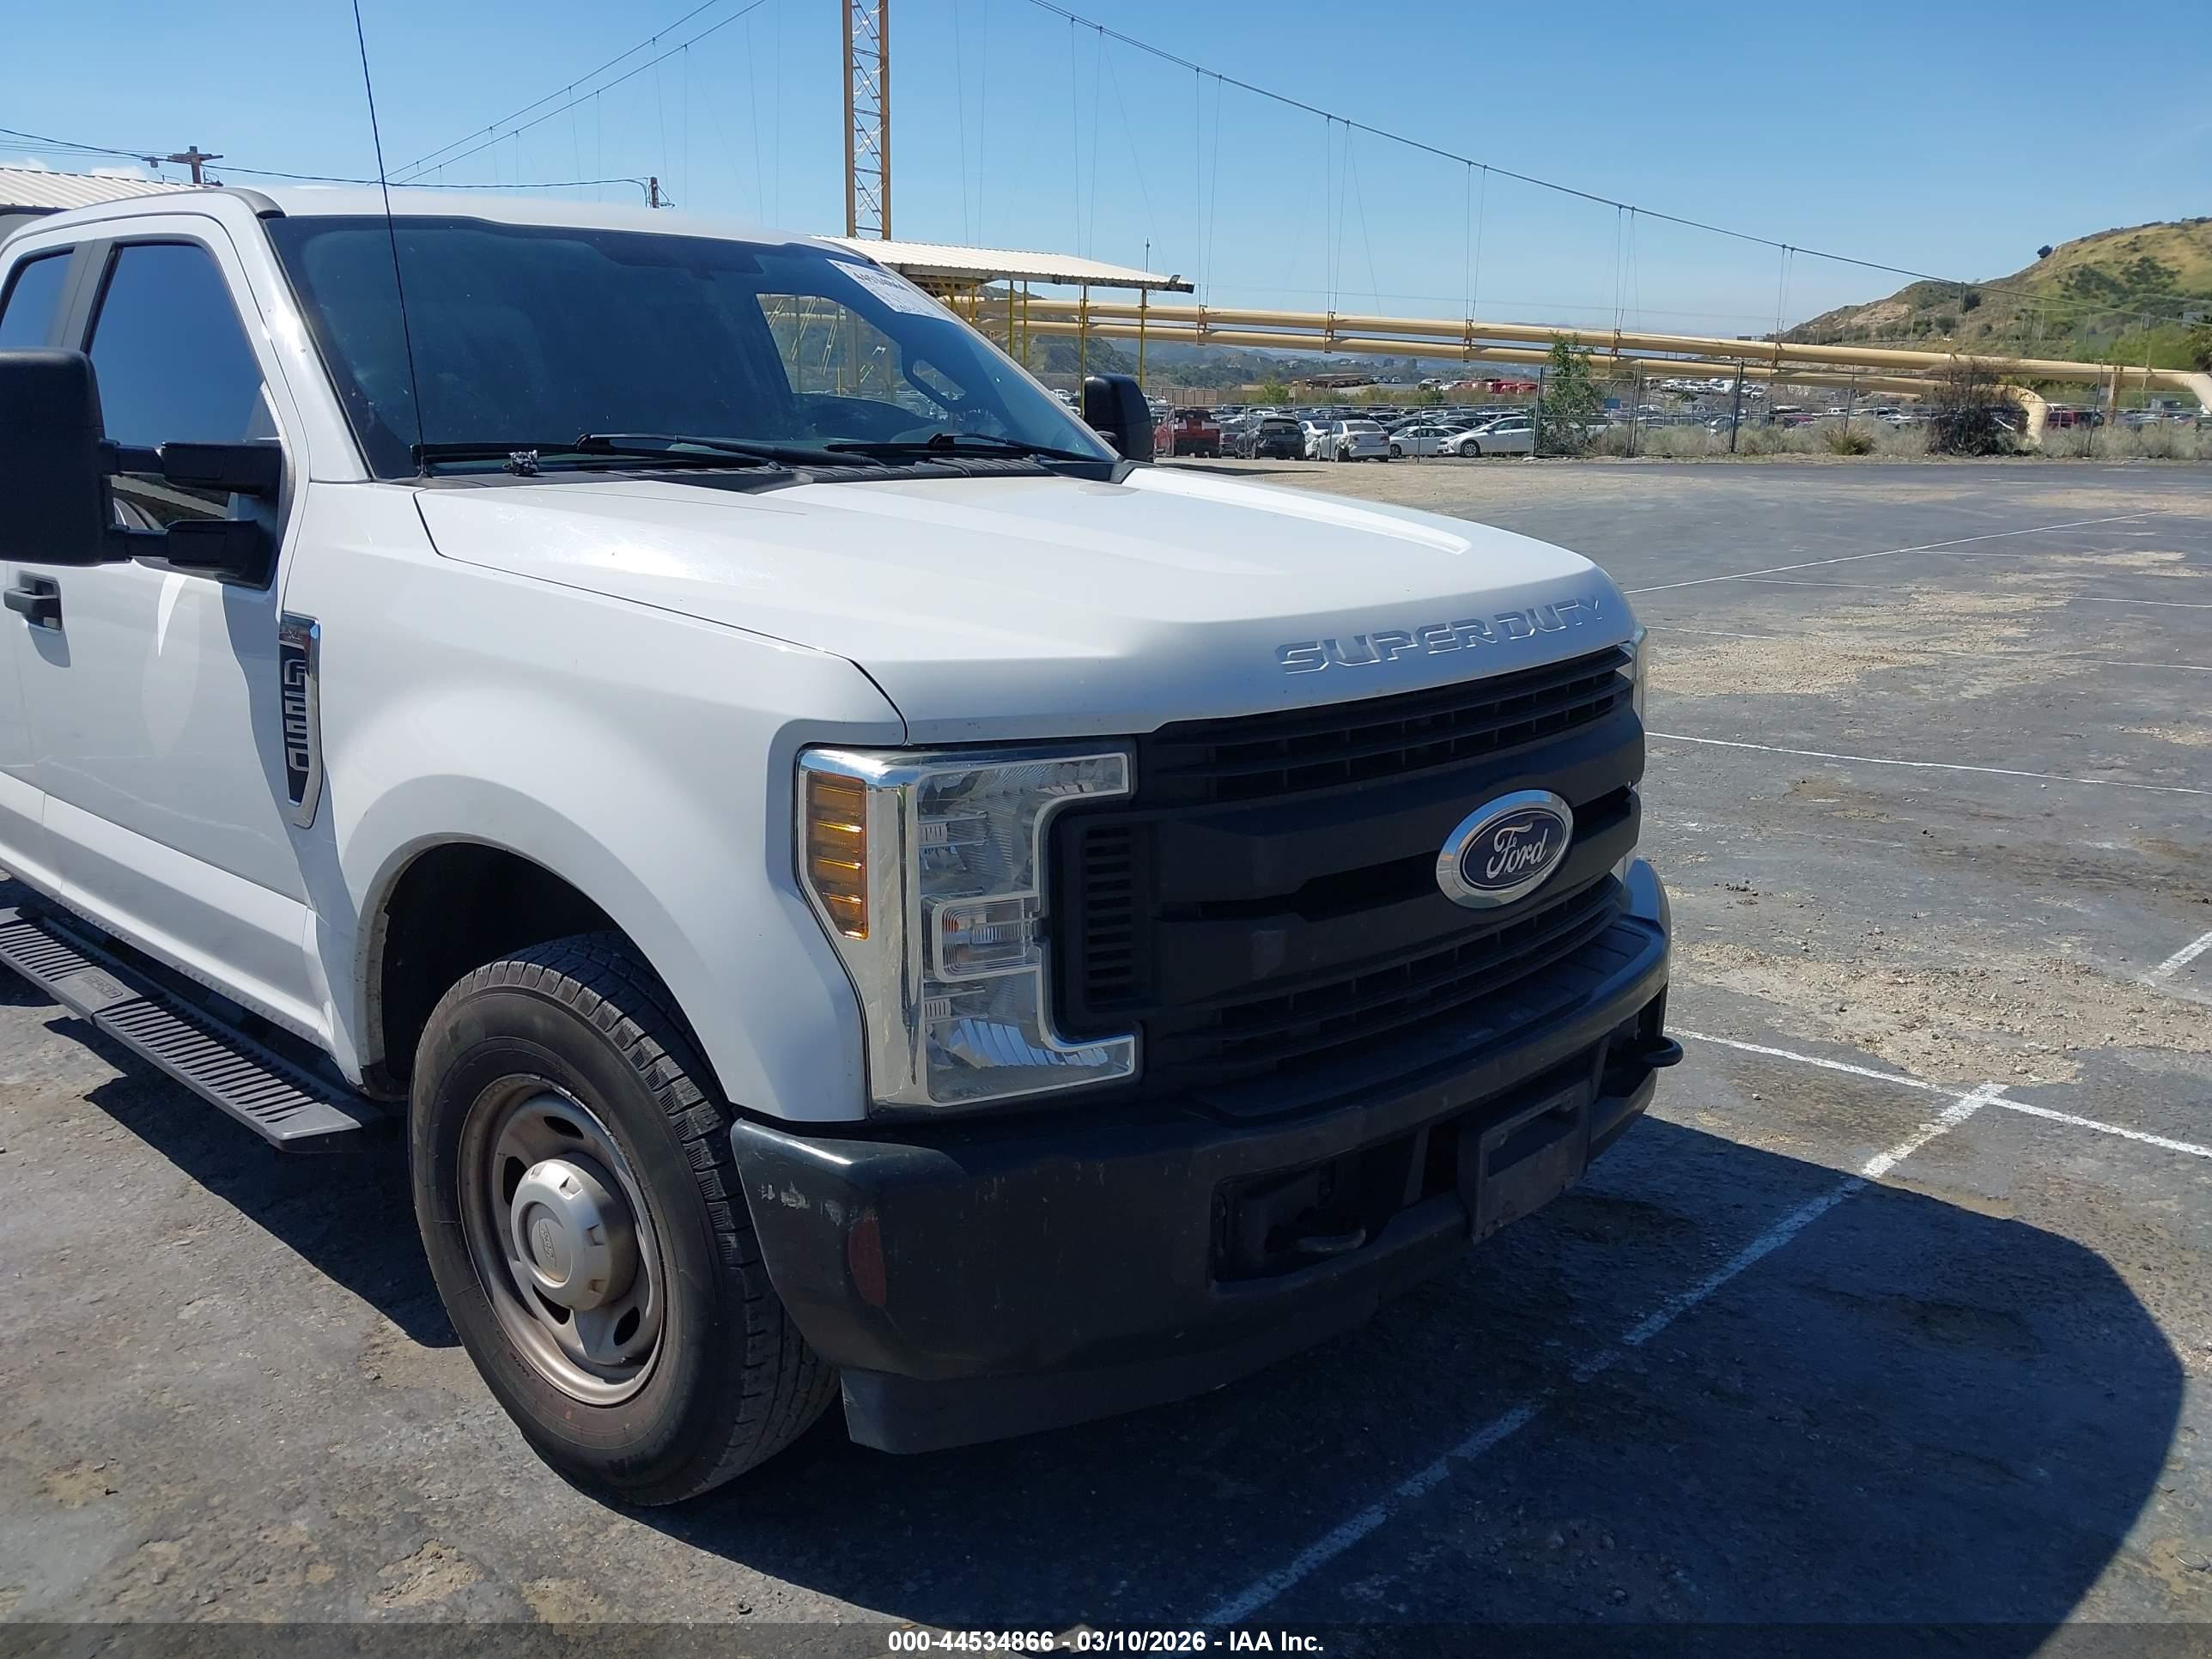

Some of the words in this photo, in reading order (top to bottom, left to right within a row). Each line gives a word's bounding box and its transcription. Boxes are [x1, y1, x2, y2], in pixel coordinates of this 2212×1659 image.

[1274, 618, 1498, 675] SUPER
[1492, 597, 1604, 641] DUTY
[1486, 822, 1548, 879] Ford
